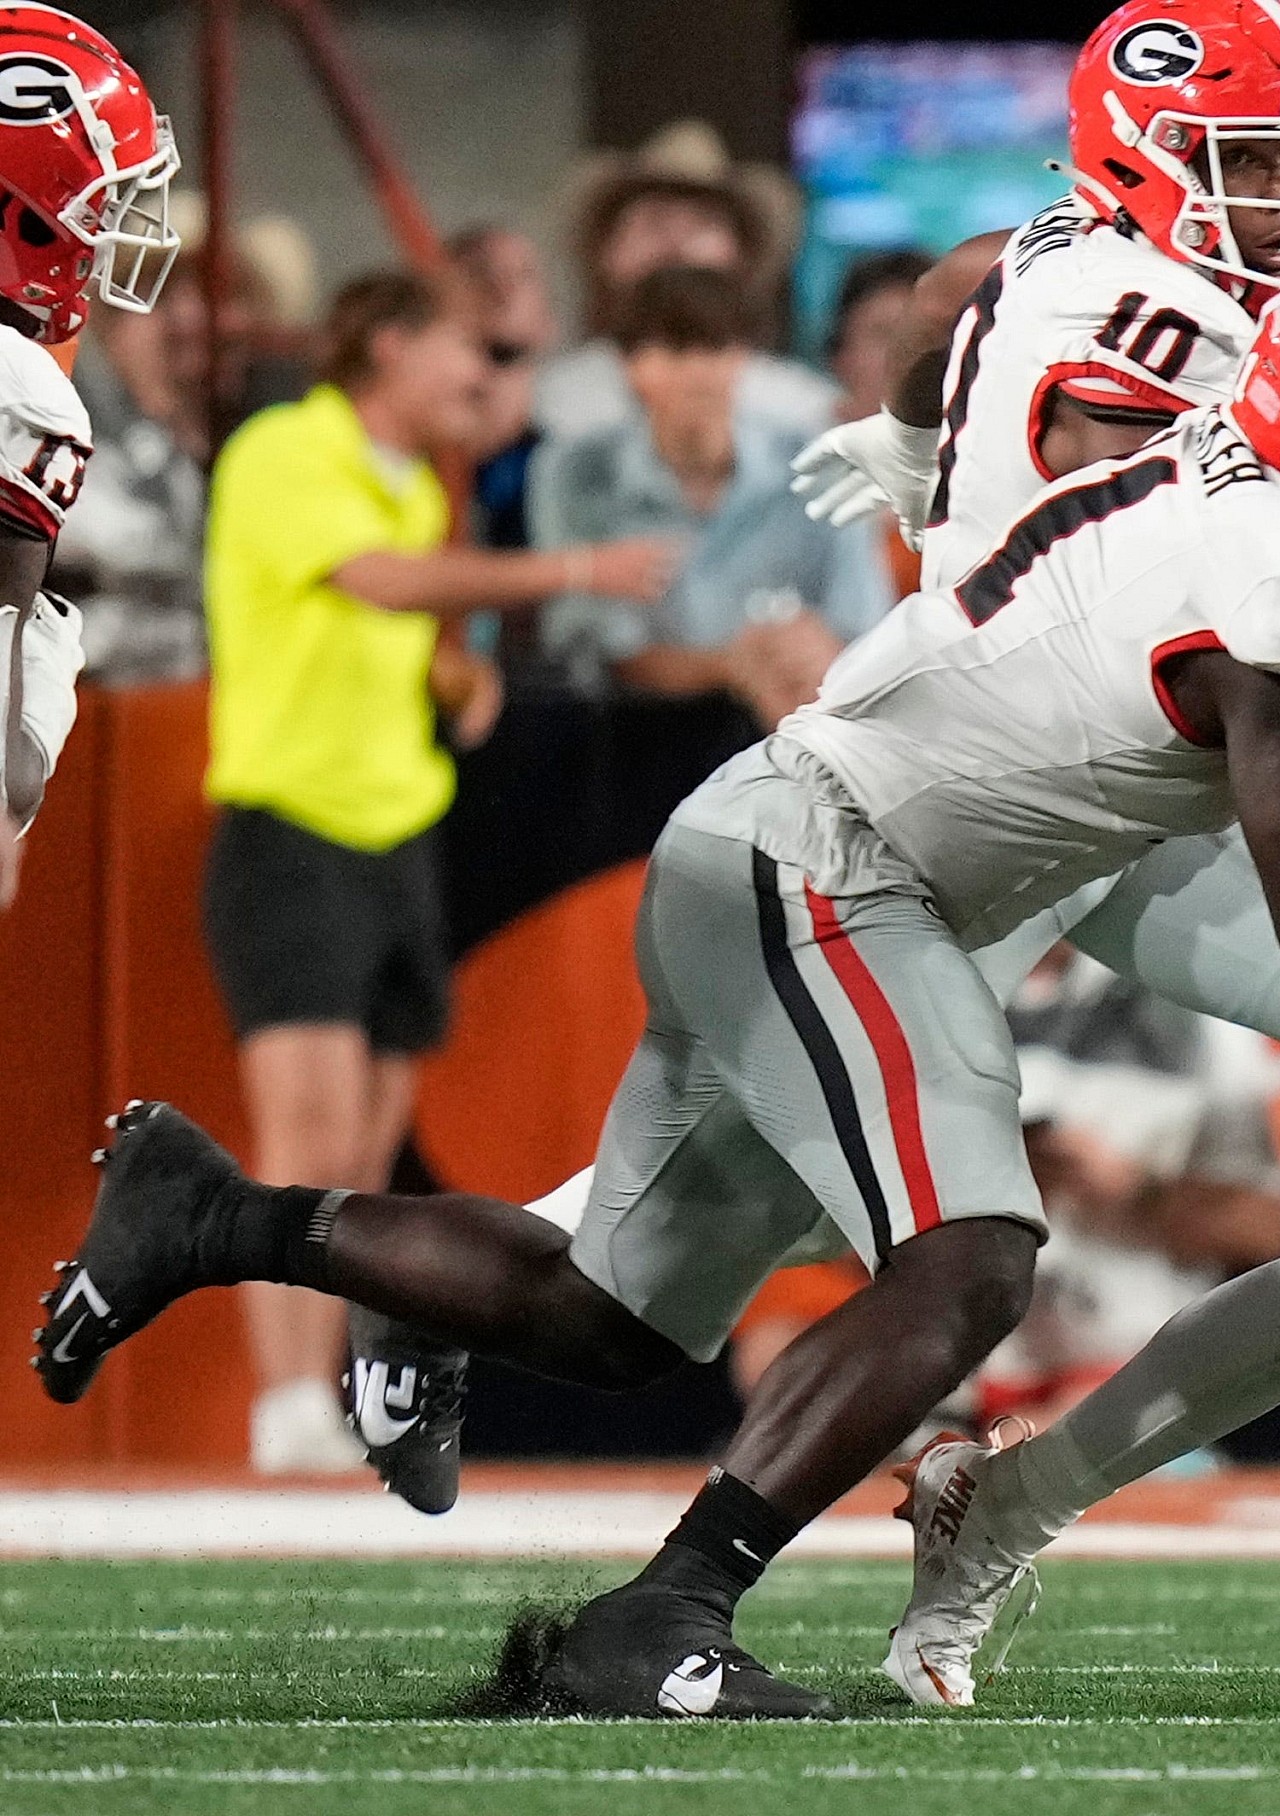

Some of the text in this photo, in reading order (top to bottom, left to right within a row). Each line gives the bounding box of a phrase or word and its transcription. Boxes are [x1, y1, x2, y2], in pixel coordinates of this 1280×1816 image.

[1112, 22, 1199, 82] G
[1092, 291, 1202, 384] 10
[22, 433, 96, 512] 13
[930, 1466, 977, 1546] NIKE
